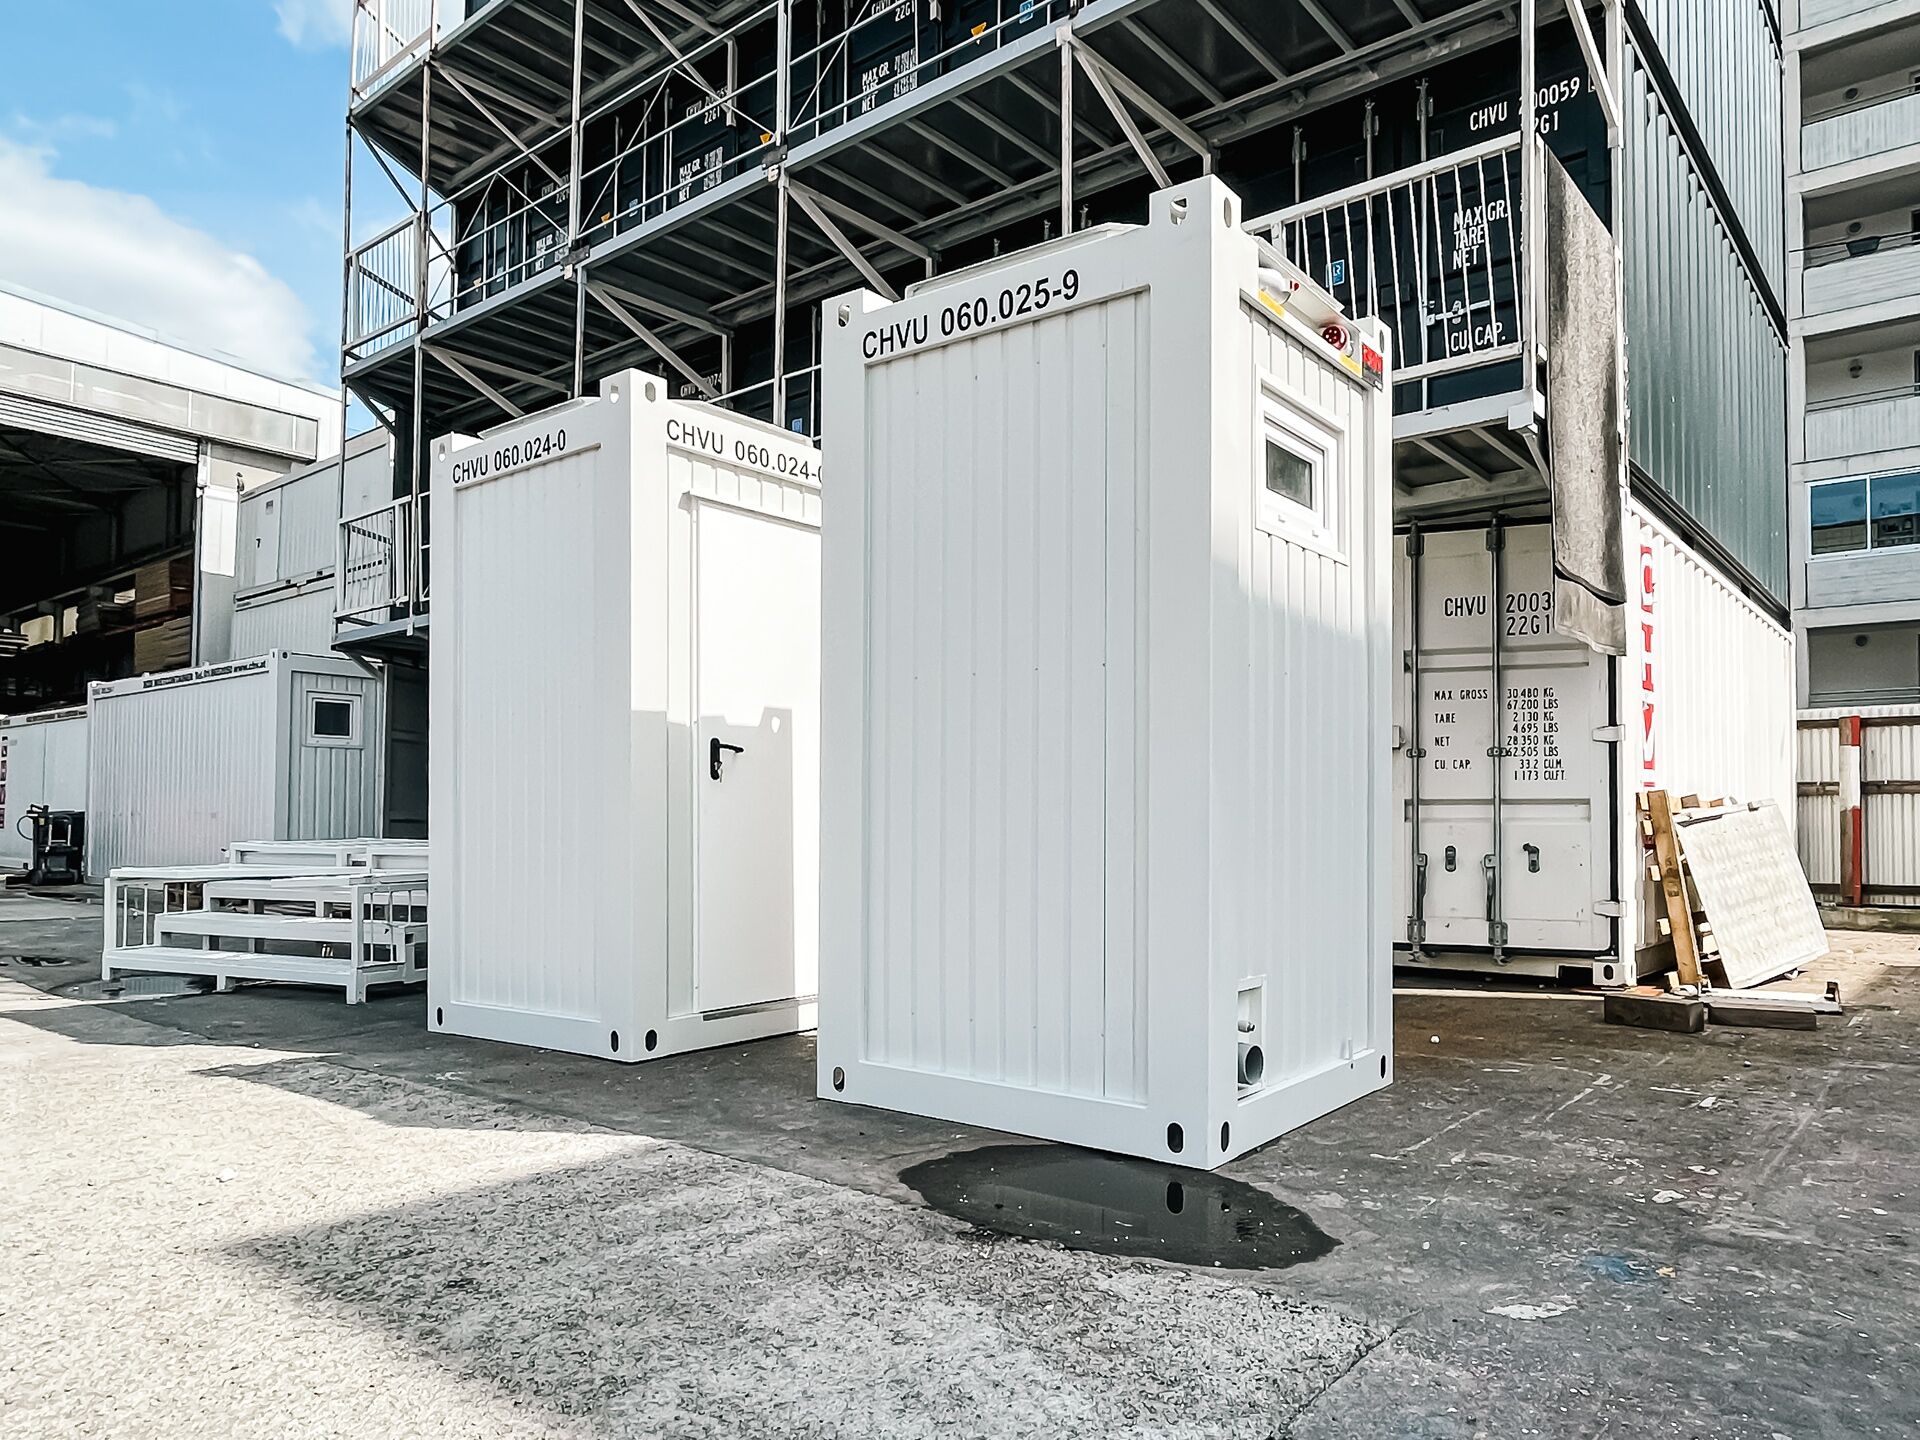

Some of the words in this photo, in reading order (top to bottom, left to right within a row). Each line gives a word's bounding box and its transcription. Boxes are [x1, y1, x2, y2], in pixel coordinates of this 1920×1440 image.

[1469, 101, 1508, 131] CHVU
[1453, 205, 1484, 231] MAX
[1454, 224, 1485, 250] TARE
[1453, 246, 1479, 270] NET
[863, 315, 929, 359] CHVU
[941, 269, 1080, 337] 060.025-9
[1475, 322, 1506, 346] CAP.
[666, 419, 724, 455] CHVU
[452, 454, 490, 485] CHVU
[494, 429, 567, 473] 060.024-0
[1444, 595, 1486, 617] CHVU
[1506, 614, 1550, 636] 22G1
[1459, 688, 1488, 700] GROSS
[1543, 687, 1554, 698] KG
[1543, 698, 1559, 710] LBS
[1434, 712, 1456, 724] TARE
[1543, 711, 1554, 721] KG
[1543, 722, 1559, 733] LBS
[1434, 736, 1450, 747] NET
[1543, 734, 1554, 745] KG
[1543, 746, 1559, 757] LBS
